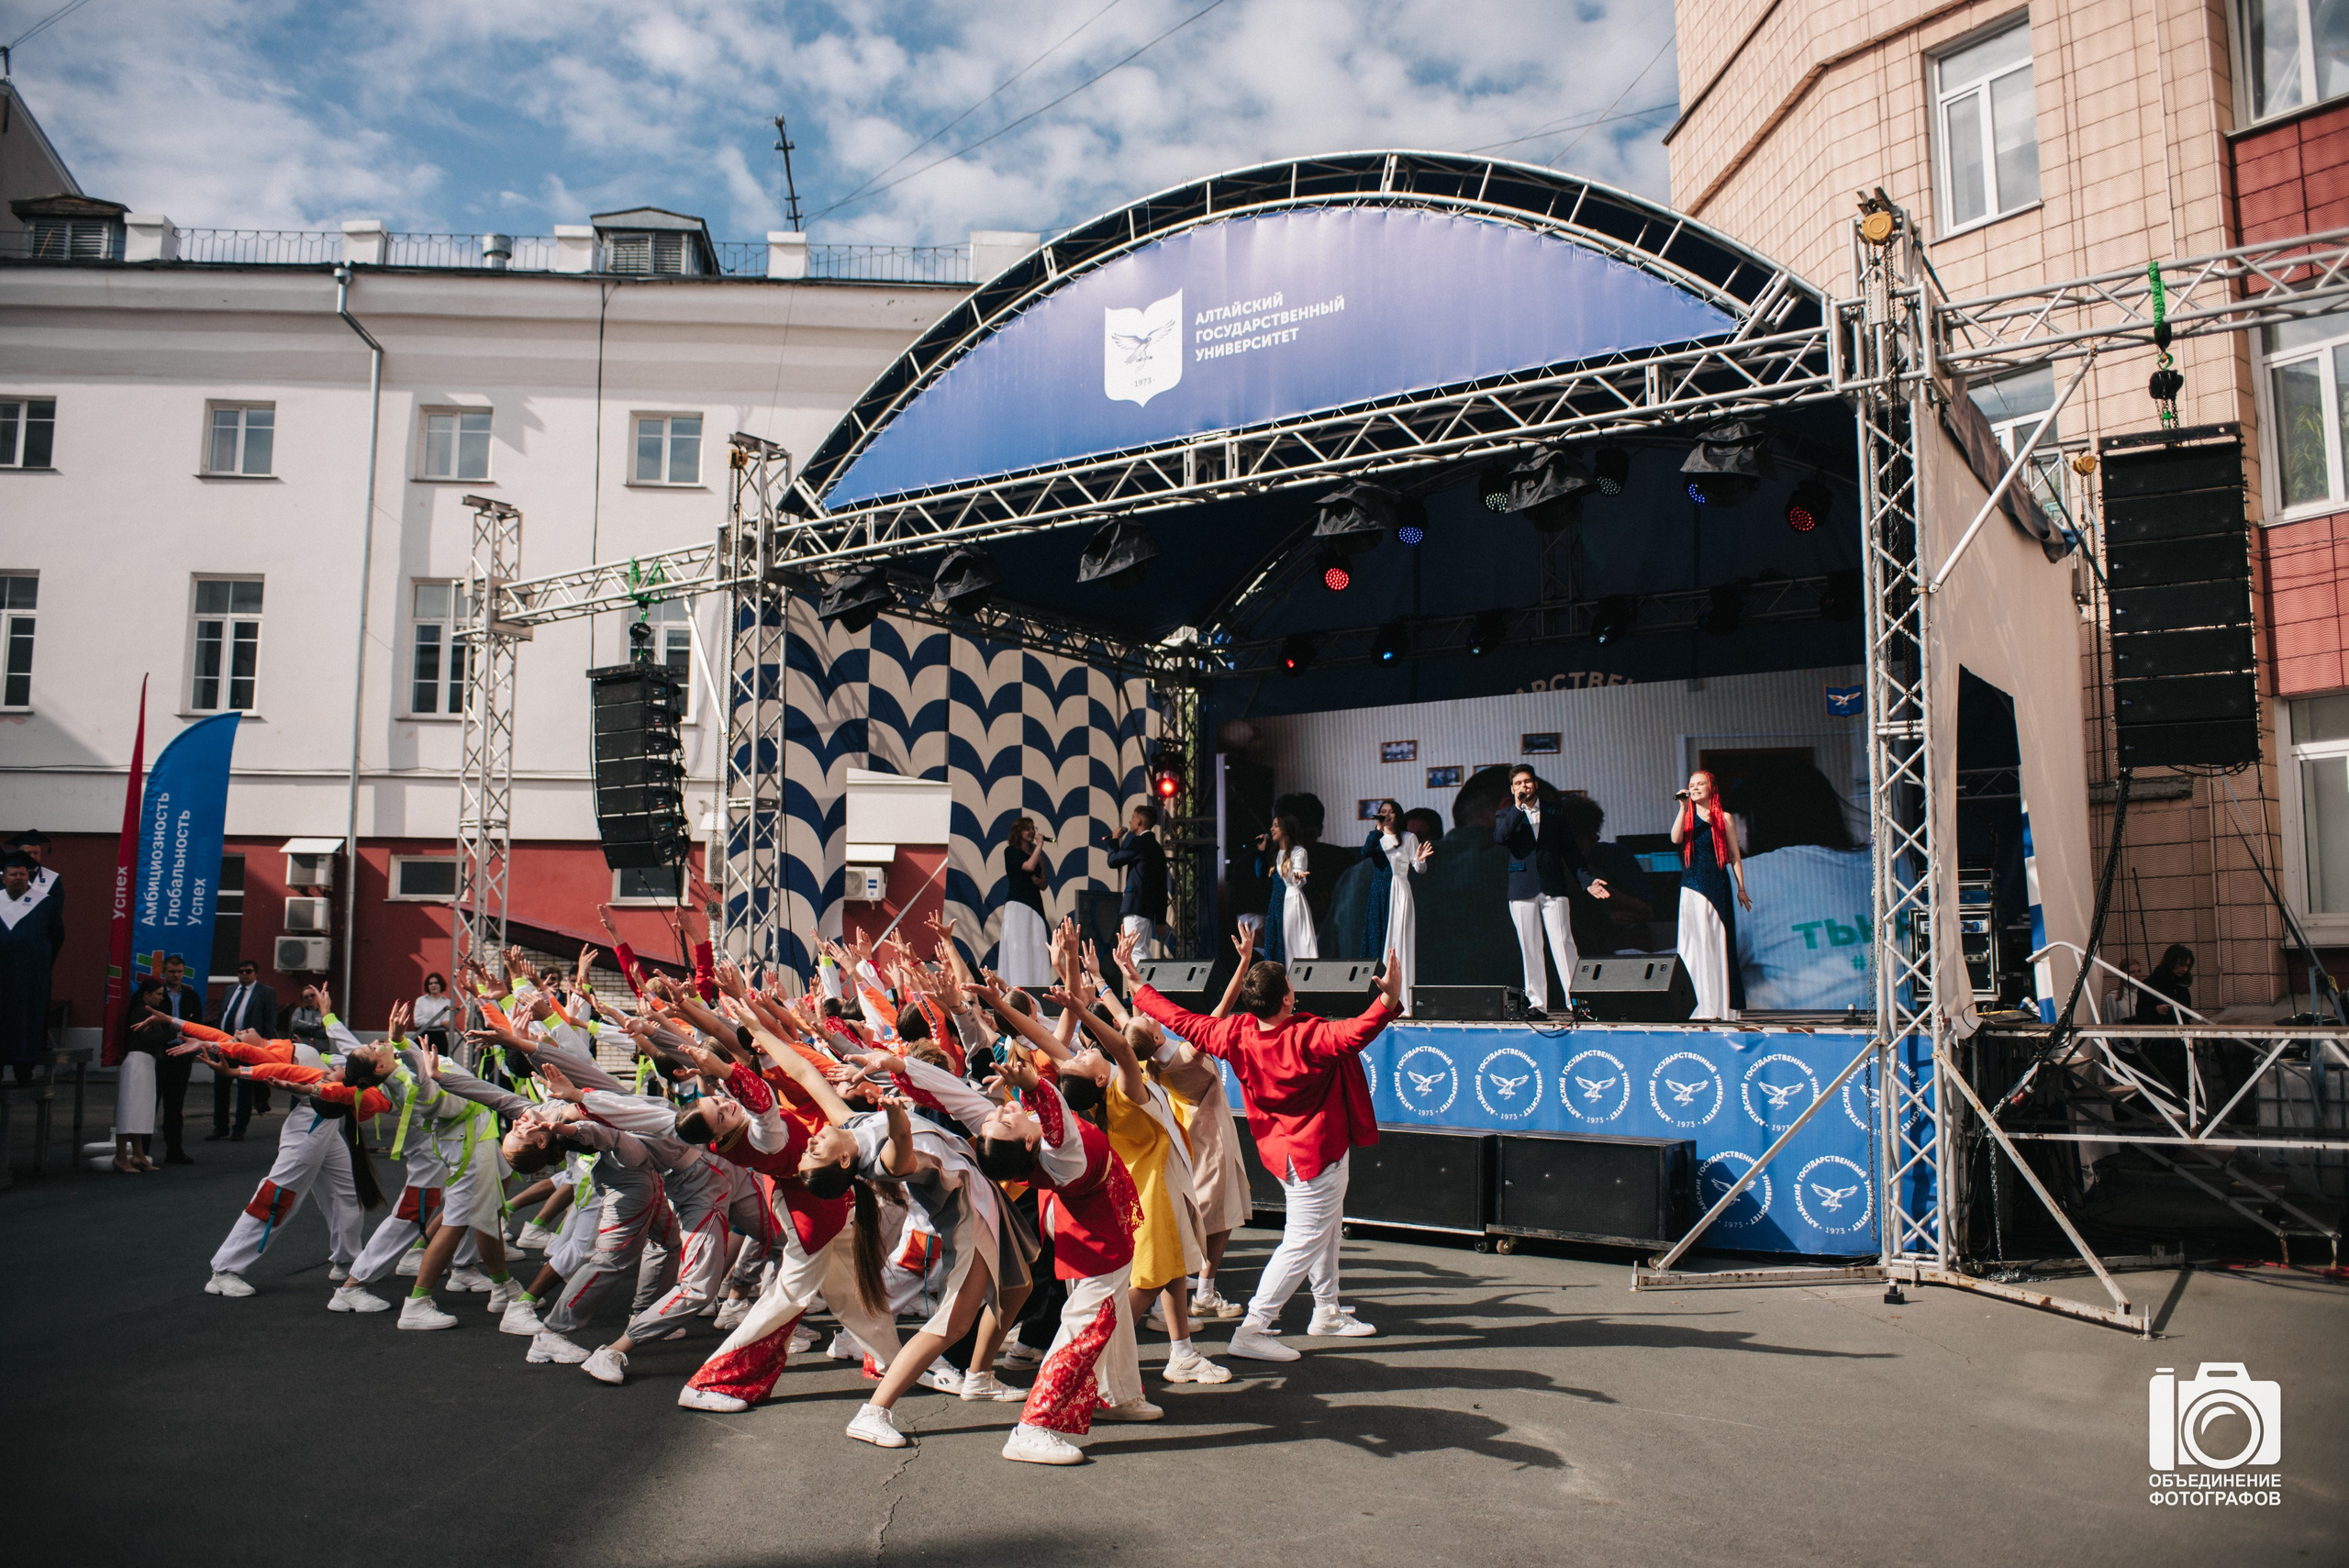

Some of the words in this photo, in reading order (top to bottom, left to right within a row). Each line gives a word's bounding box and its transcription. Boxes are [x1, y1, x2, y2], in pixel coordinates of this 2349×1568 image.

[1195, 291, 1284, 326] АЛТАЙСКИЙ
[1196, 295, 1345, 344] ГОСУДАРСТВЕННЫЙ
[1196, 328, 1299, 361] УНИВЕРСИТЕТ
[1134, 377, 1152, 387] 1973
[141, 793, 170, 927] Амбициозность
[164, 810, 191, 926] Глобальность
[112, 866, 128, 920] Успех
[187, 877, 206, 926] Успех
[1397, 1046, 1453, 1070] ГОСУДАРСТВЕННЫЙ
[1478, 1048, 1537, 1073] ГОСУДАРСТВЕННЫЙ
[1562, 1050, 1625, 1075] ГОСУДАРСТВЕННЫЙ
[1652, 1051, 1718, 1078] ГОСУДАРСТВЕННЫЙ
[1743, 1053, 1813, 1081] ГОСУДАРСТВЕННЫЙ
[1394, 1072, 1414, 1111] АЛТАЙСКИЙ
[1440, 1066, 1458, 1113] УНИВЕРСИТЕТ
[1475, 1074, 1496, 1115] АЛТАЙСКИЙ
[1523, 1068, 1543, 1117] УНИВЕРСИТЕТ
[1559, 1077, 1581, 1118] АЛТАЙСКИЙ
[1609, 1072, 1631, 1120] УНИВЕРСИТЕТ
[1649, 1080, 1671, 1123] АЛТАЙСКИЙ
[1702, 1073, 1724, 1125] УНИВЕРСИТЕТ
[1741, 1083, 1765, 1126] АЛТАЙСКИЙ
[1842, 1085, 1867, 1129] АЛТАЙСКИЙ
[1418, 1108, 1433, 1117] 1973
[1797, 1155, 1867, 1182] ГОСУДАРСТВЕННЫЙ
[1750, 1174, 1772, 1225] УНИВЕРСИТЕТ
[1794, 1183, 1819, 1229] АЛТАЙСКИЙ
